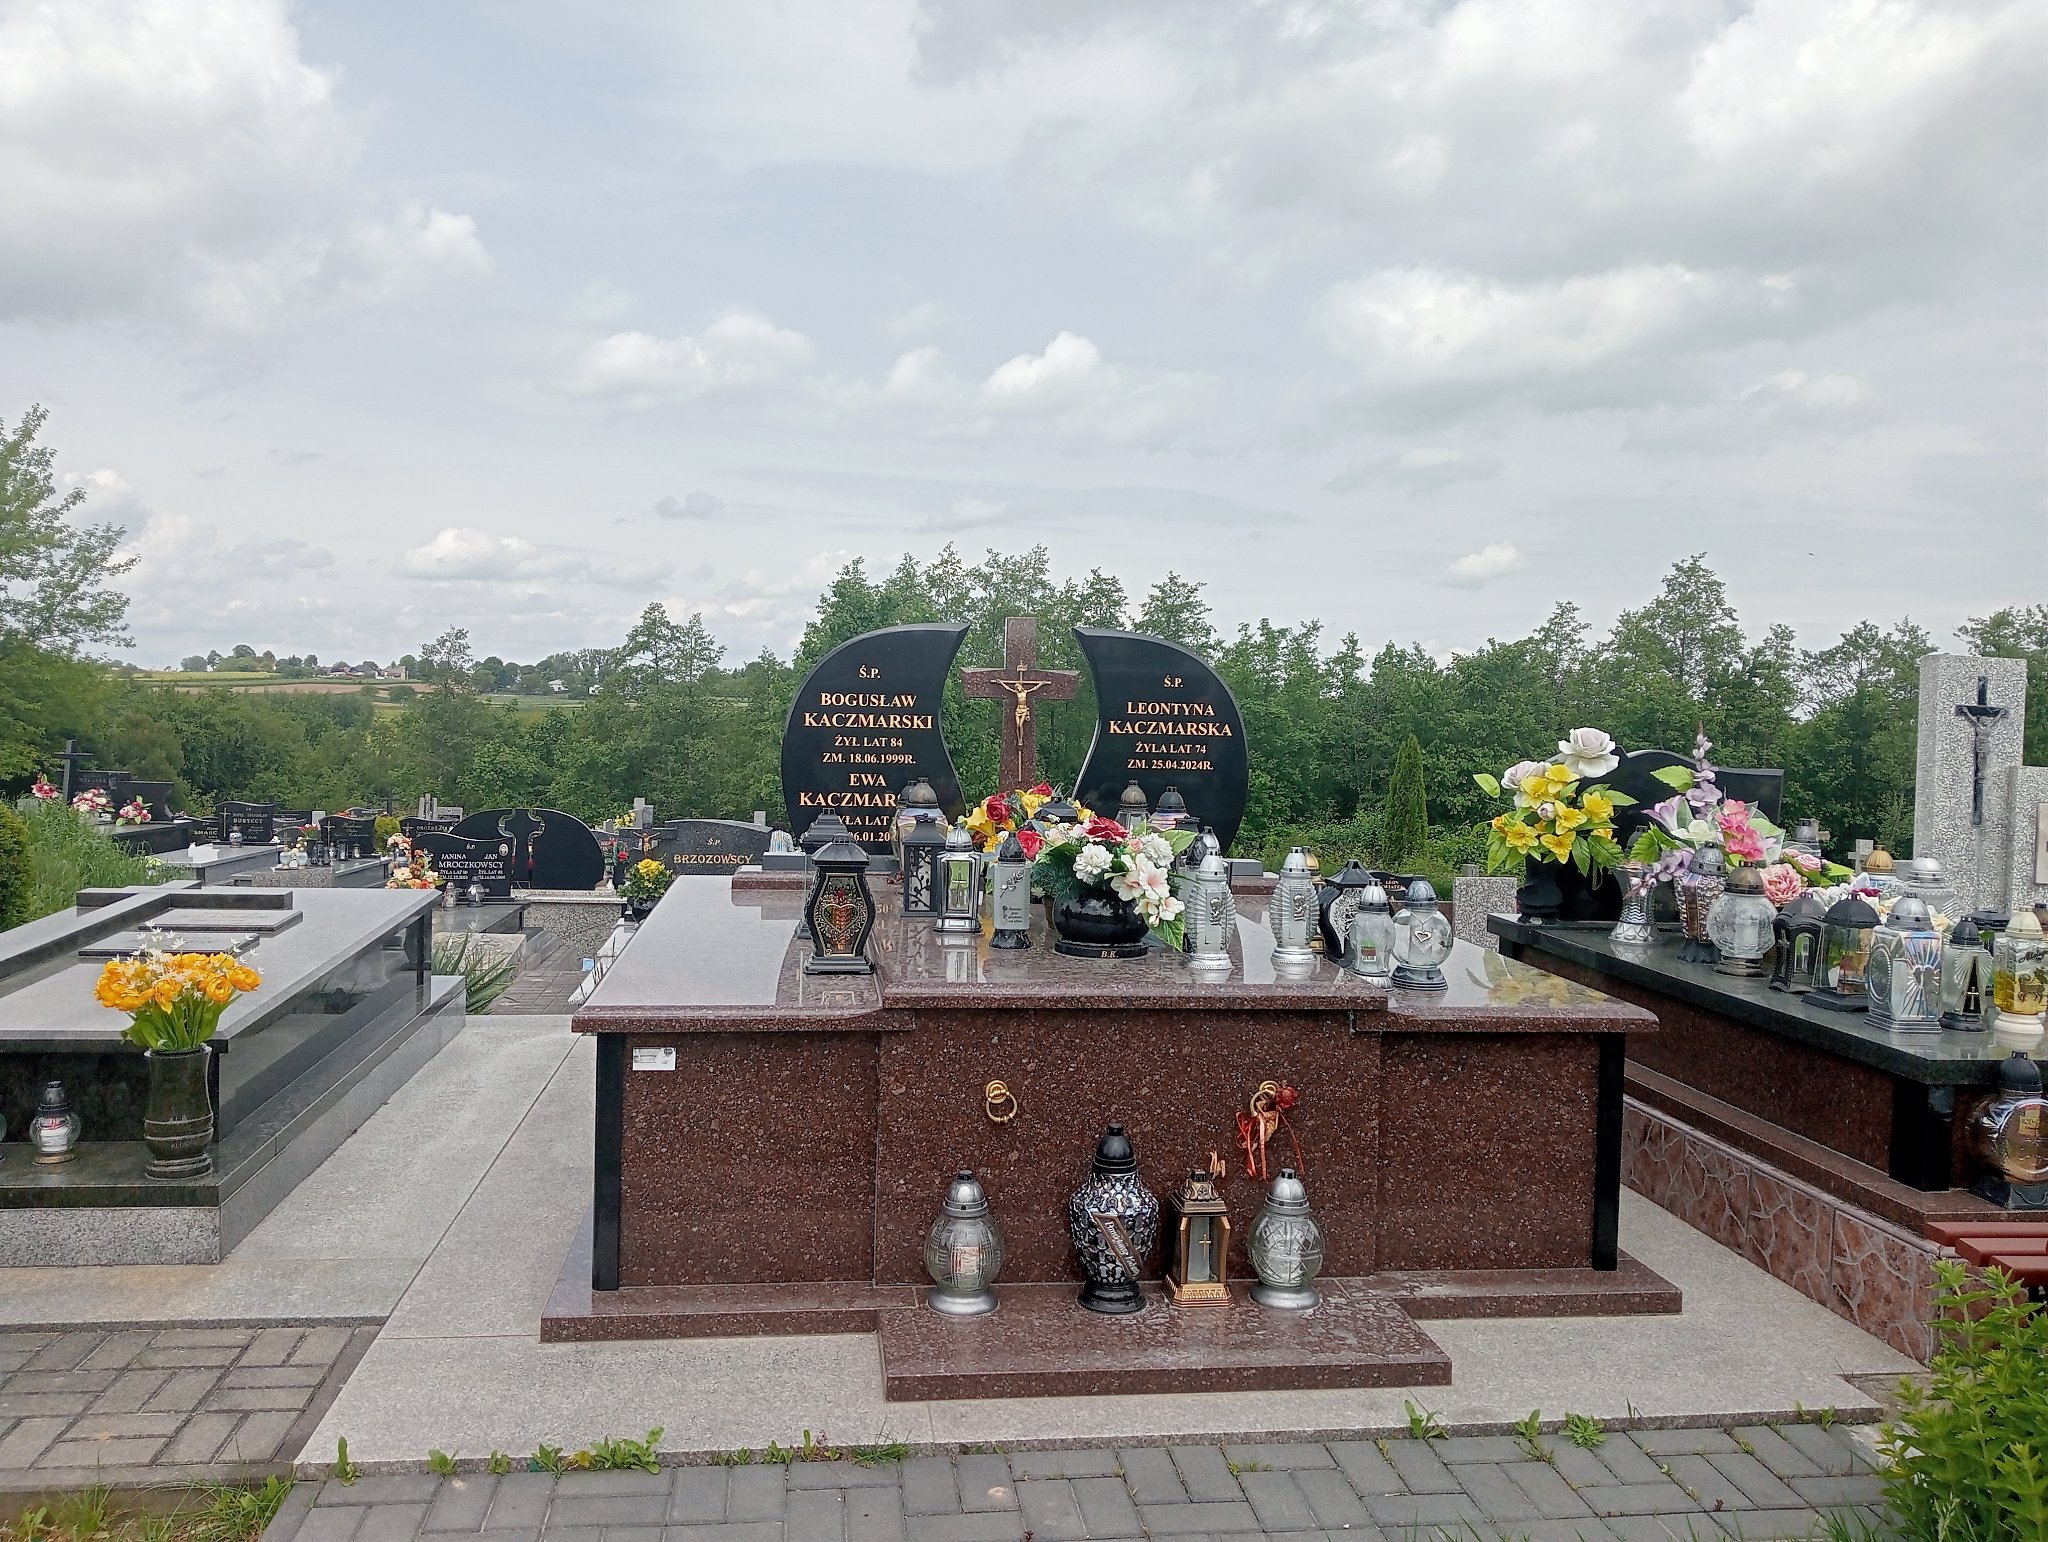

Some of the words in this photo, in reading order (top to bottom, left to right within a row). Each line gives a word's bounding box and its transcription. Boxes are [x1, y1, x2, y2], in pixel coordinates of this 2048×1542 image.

[858, 664, 881, 679] Ś.P.
[1163, 675, 1184, 688] Ś.P.
[820, 692, 918, 708] BOGUSŁAW
[1126, 701, 1215, 717] LEONTYNA
[803, 712, 934, 729] KACZMARSKI
[1108, 720, 1233, 737] KACZMARSKA
[834, 734, 860, 747] ŻYŁ
[863, 737, 888, 748] LAT
[890, 737, 903, 748] 84
[1169, 743, 1192, 754] LAT
[1195, 744, 1207, 754] 74
[822, 752, 846, 763] ZM.
[849, 753, 917, 765] 18.06.1999R.
[1127, 758, 1149, 769] ZM.
[1151, 759, 1214, 770] 25.04.2024R.
[848, 773, 888, 787] EWA
[799, 791, 902, 808] KACZMAR
[865, 815, 890, 826] LAT
[438, 860, 505, 869] MROCZKOWSCY
[673, 853, 753, 865] BRZOZOWSCY
